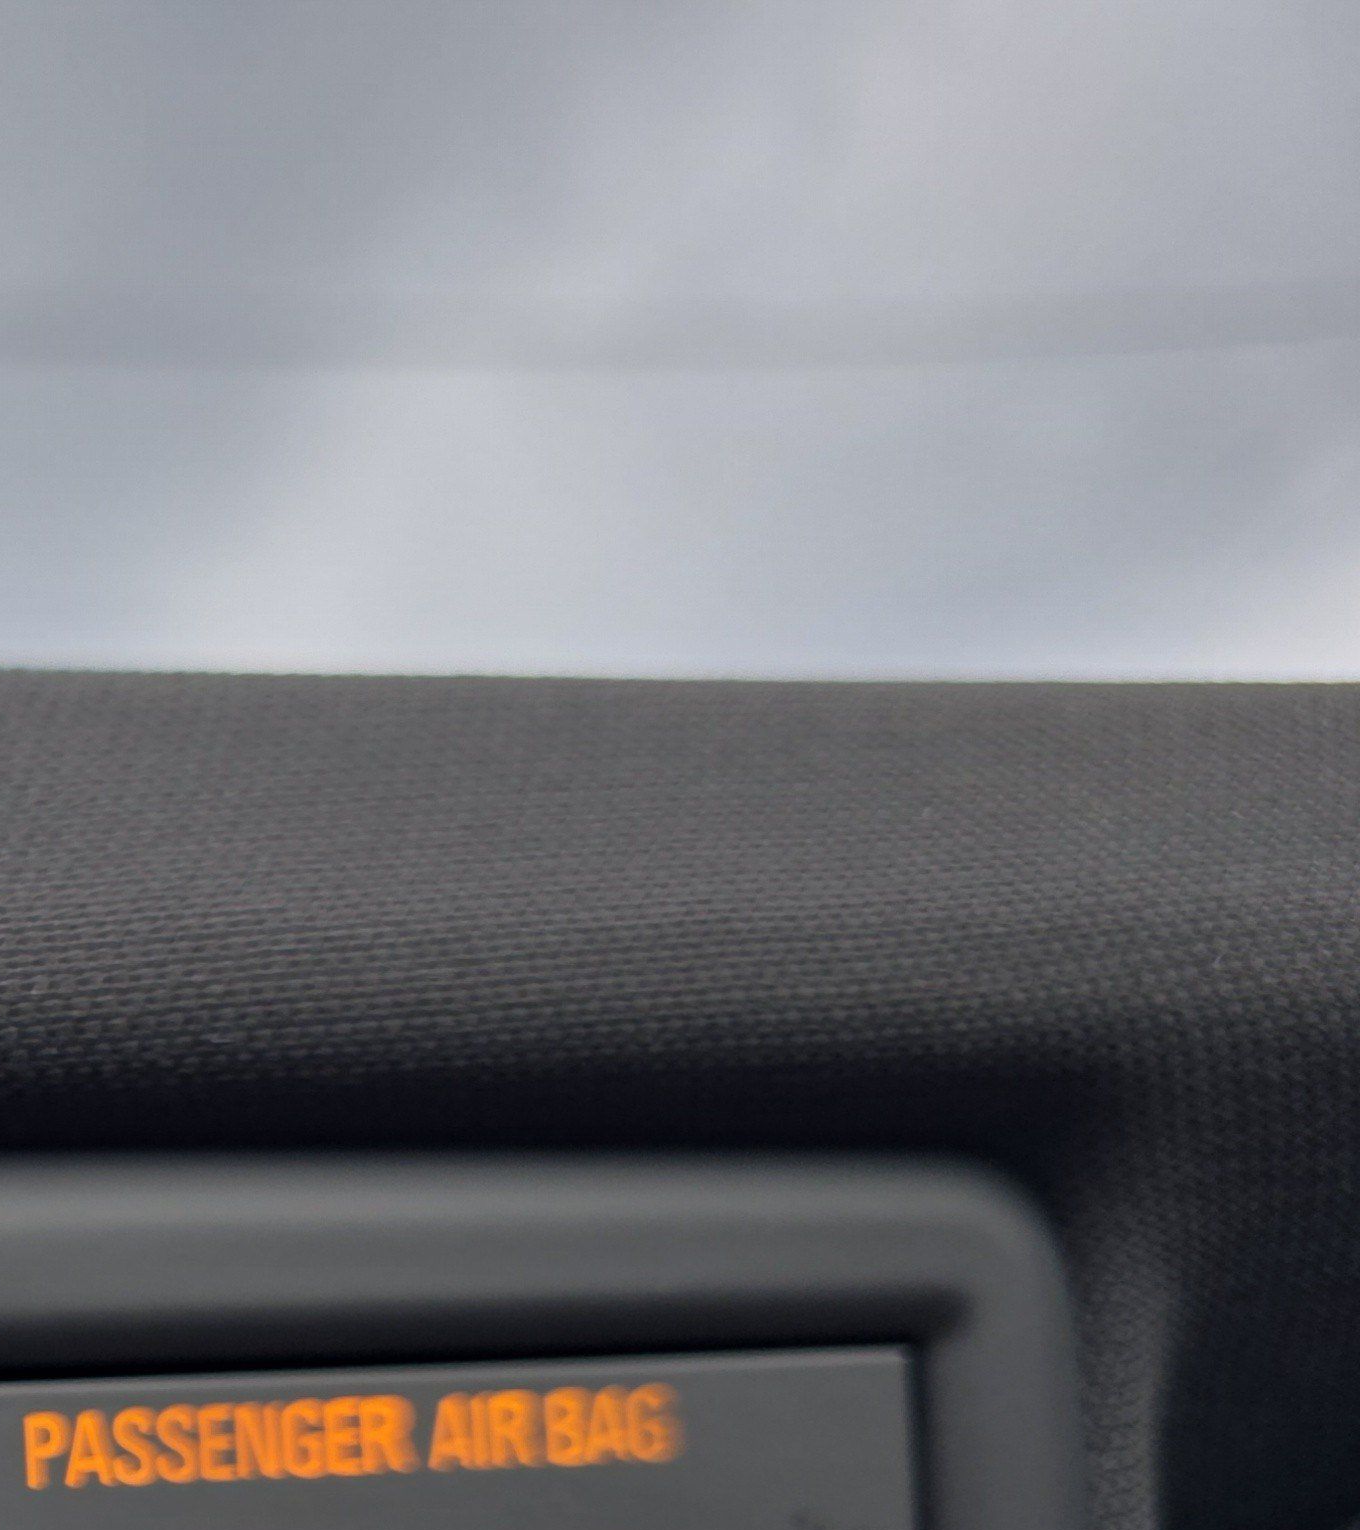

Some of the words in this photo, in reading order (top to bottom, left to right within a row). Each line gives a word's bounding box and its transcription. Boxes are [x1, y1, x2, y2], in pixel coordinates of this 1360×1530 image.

[23, 1394, 417, 1489] PASSENGER
[427, 1389, 543, 1470] AIR
[544, 1383, 680, 1467] BAG
